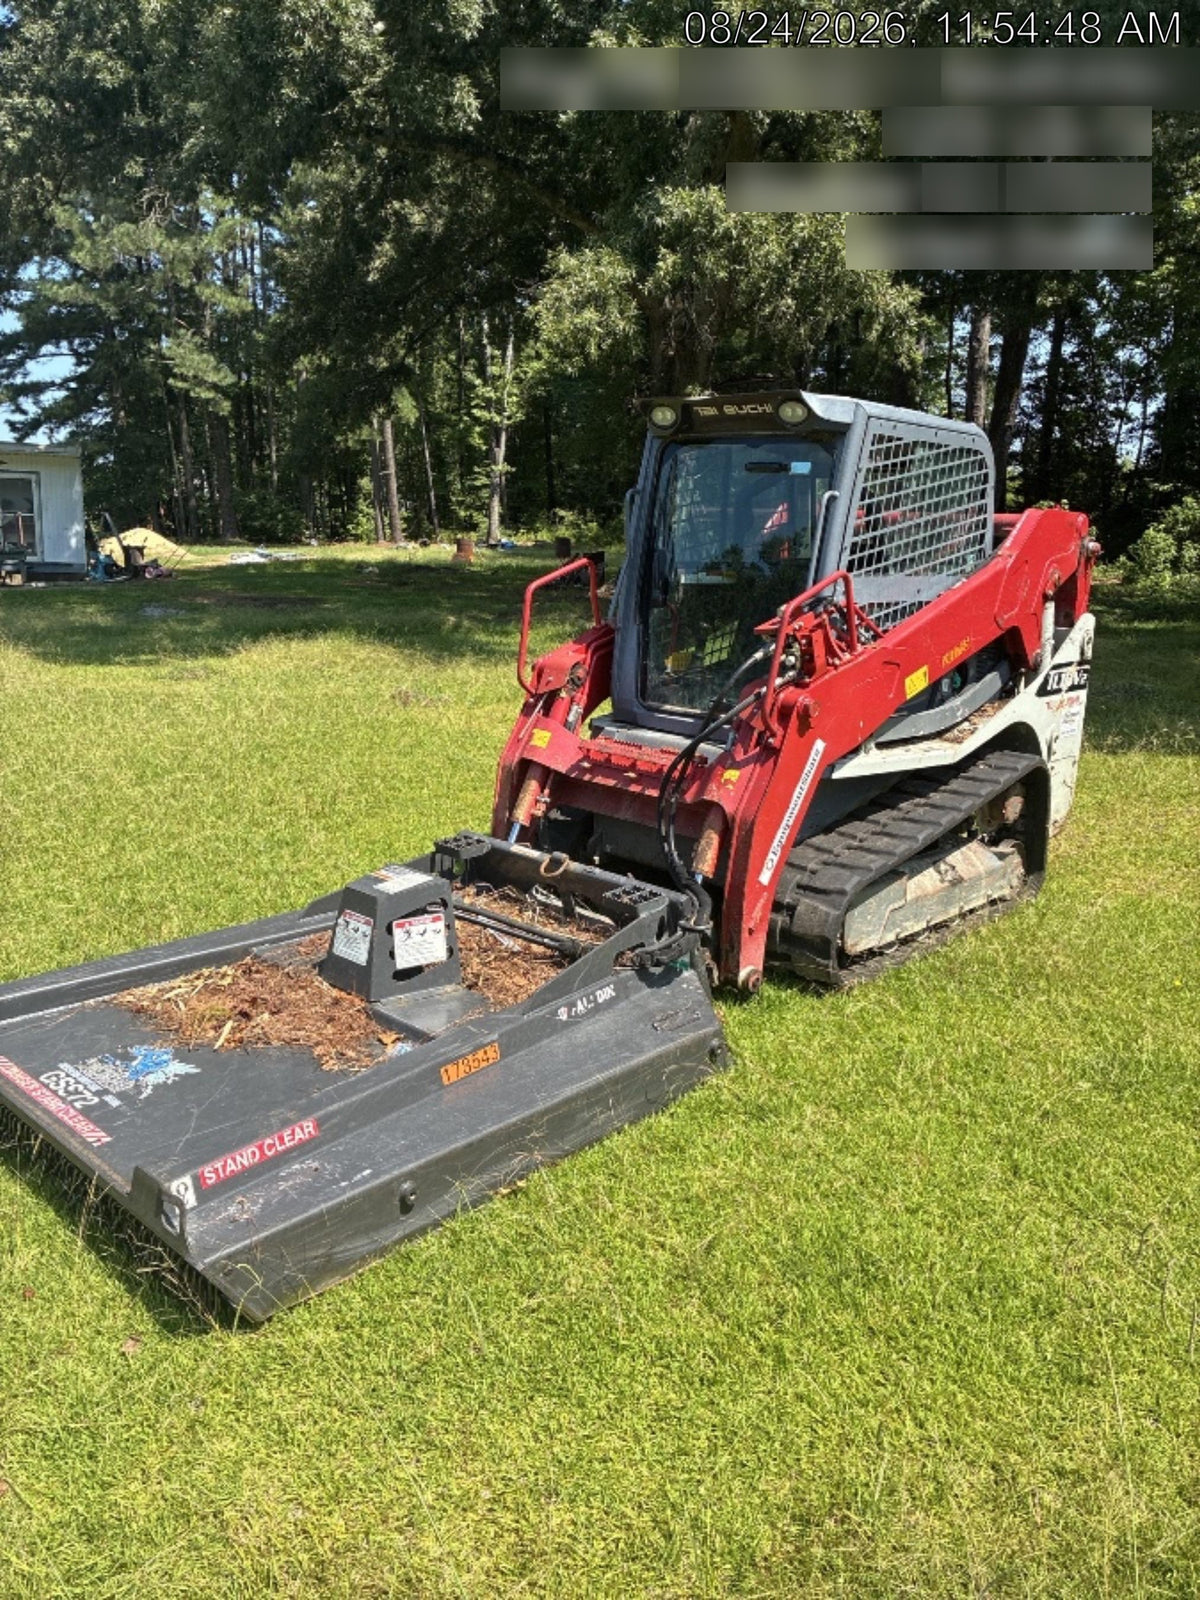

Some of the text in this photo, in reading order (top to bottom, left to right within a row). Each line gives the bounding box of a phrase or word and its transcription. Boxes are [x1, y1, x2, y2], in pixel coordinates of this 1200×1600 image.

[444, 1044, 499, 1082] 173543
[202, 1119, 316, 1185] STAND CLEAR
